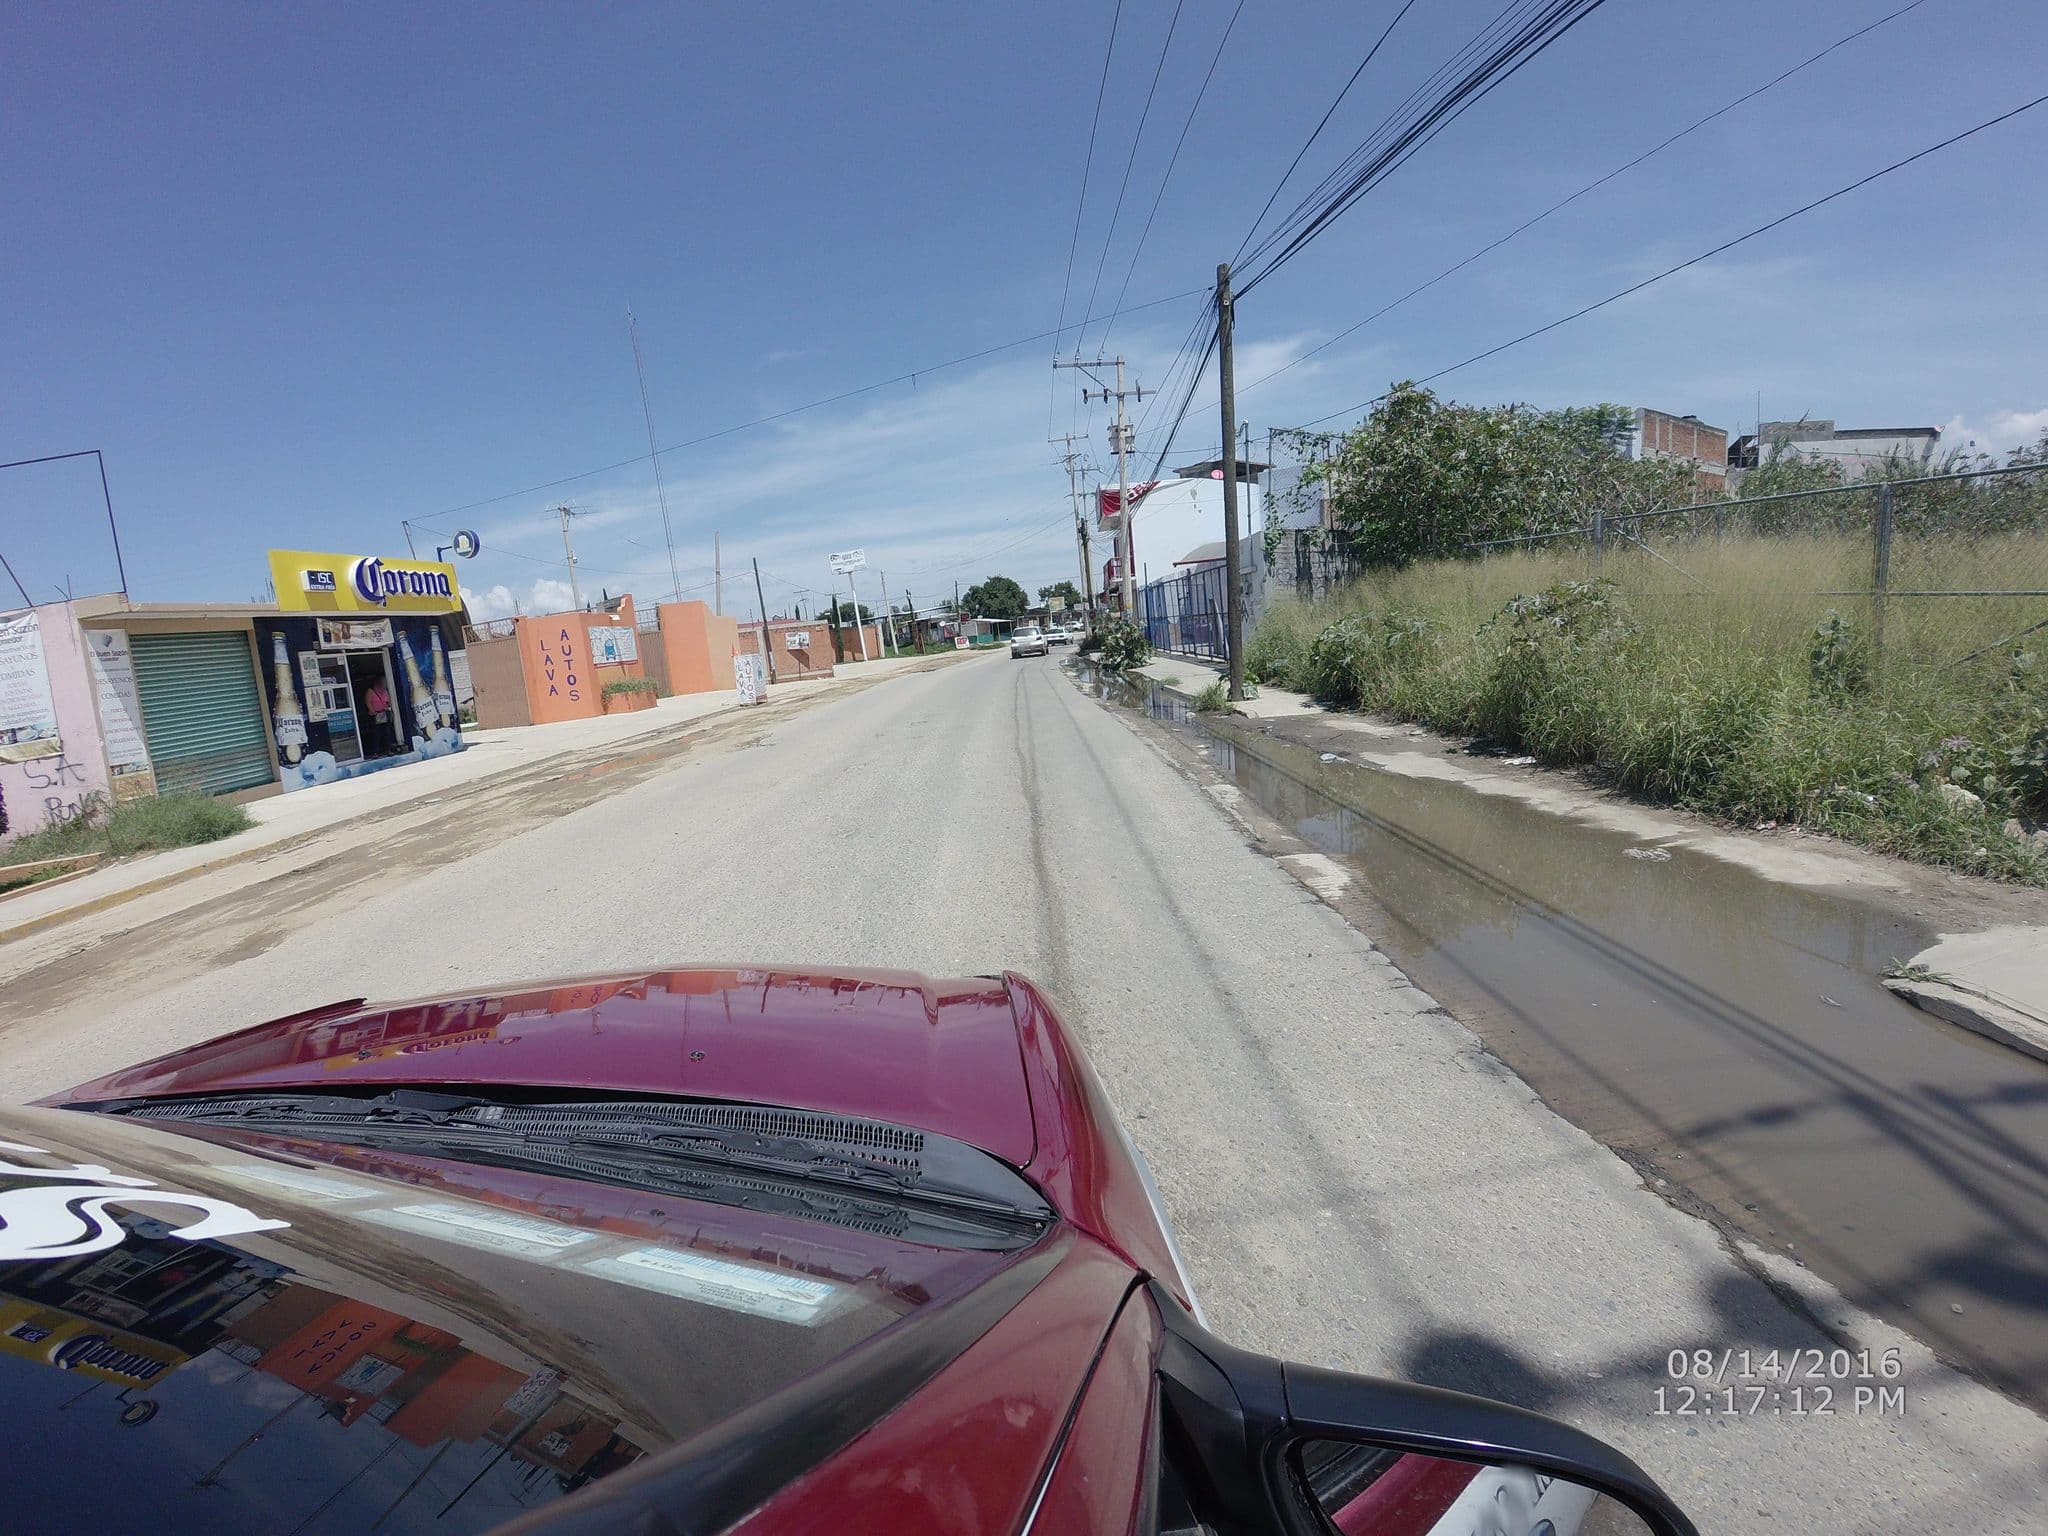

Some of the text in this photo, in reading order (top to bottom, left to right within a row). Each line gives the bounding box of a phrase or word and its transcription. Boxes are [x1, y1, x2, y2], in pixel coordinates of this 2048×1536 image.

[355, 556, 454, 608] Corona
[540, 639, 559, 697] LAVA
[560, 628, 580, 702] AUTOS
[737, 664, 746, 696] LAVA
[745, 660, 754, 700] AUTOS
